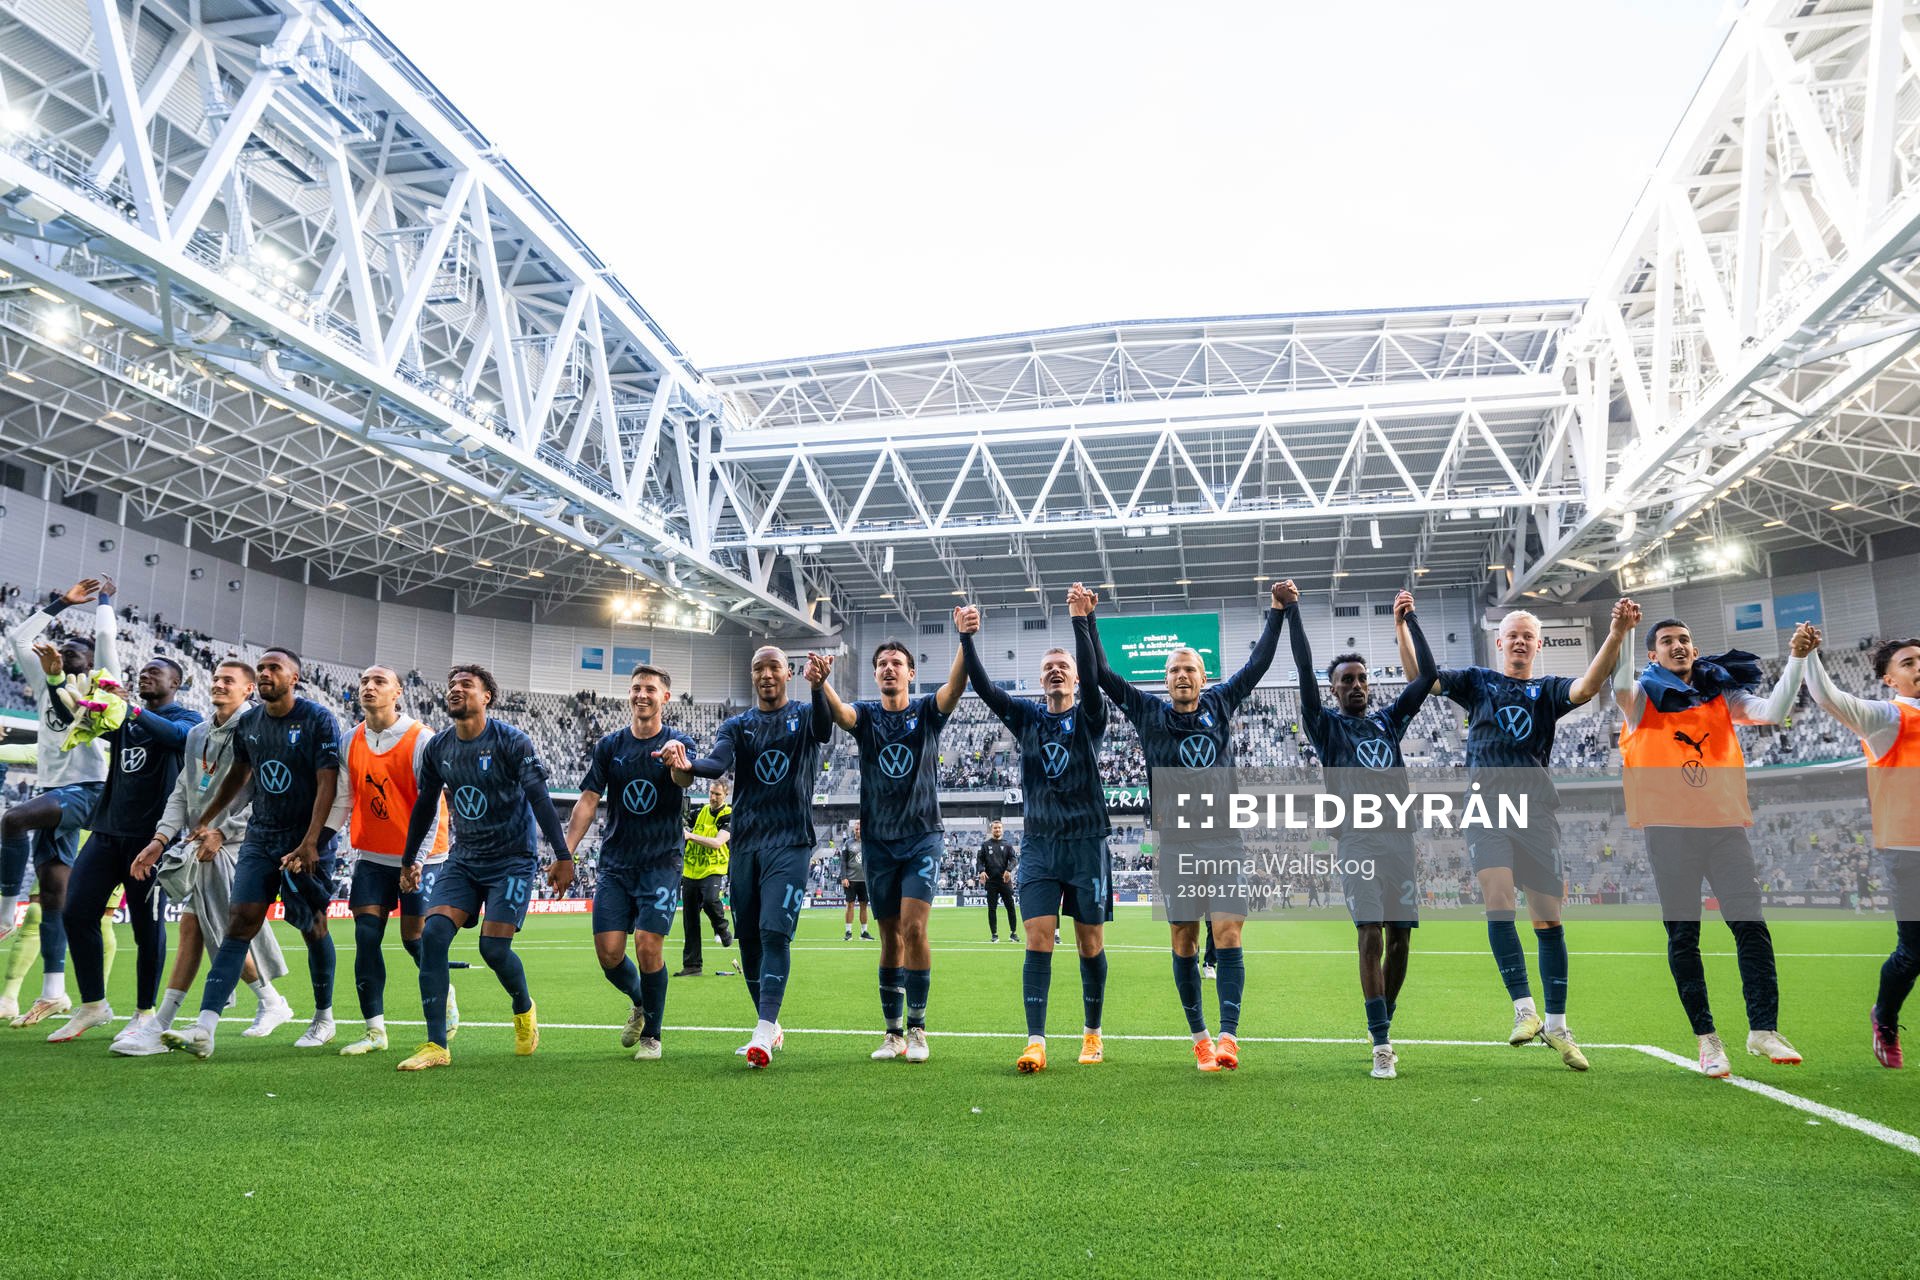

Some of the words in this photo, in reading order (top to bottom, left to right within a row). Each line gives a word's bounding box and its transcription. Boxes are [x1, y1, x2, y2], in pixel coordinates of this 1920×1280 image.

[1543, 637, 1581, 647] Arena
[1495, 705, 1533, 741] VW
[755, 749, 790, 785] VW
[878, 743, 914, 778] VW
[1041, 742, 1070, 778] VW
[1180, 734, 1217, 770] VW
[1357, 738, 1393, 771] VW
[261, 760, 292, 794] VW
[455, 785, 488, 820] VW
[623, 779, 658, 814] VW
[918, 855, 938, 884] 21
[505, 876, 527, 904] 15
[654, 886, 677, 912] 23
[782, 884, 803, 912] 19
